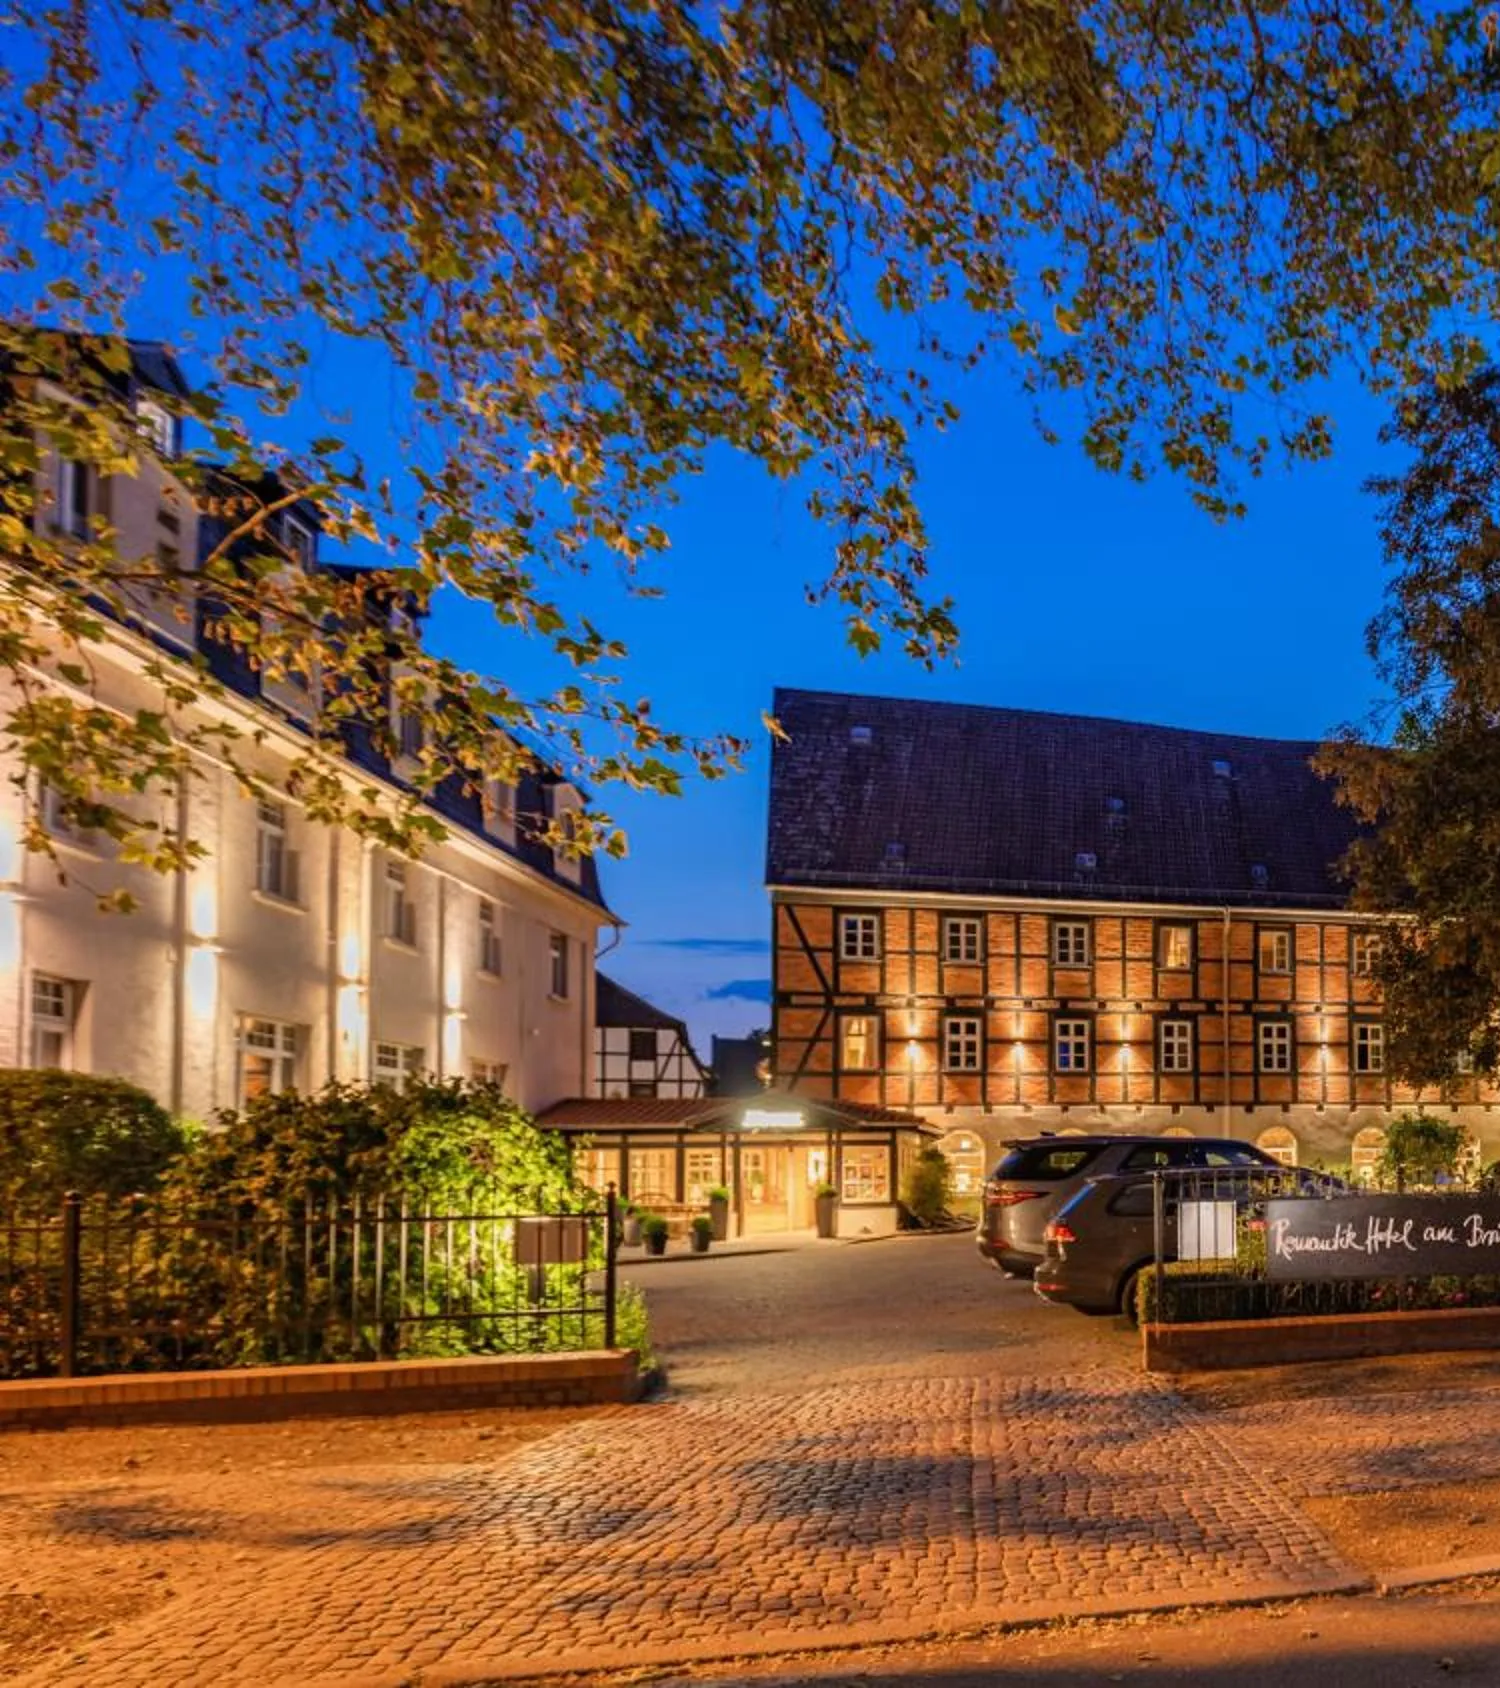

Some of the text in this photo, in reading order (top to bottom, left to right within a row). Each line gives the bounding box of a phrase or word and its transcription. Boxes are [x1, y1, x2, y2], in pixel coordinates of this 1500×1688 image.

[1270, 1217, 1365, 1261] Romantik
[1365, 1215, 1418, 1254] Hotel
[1423, 1226, 1458, 1243] am
